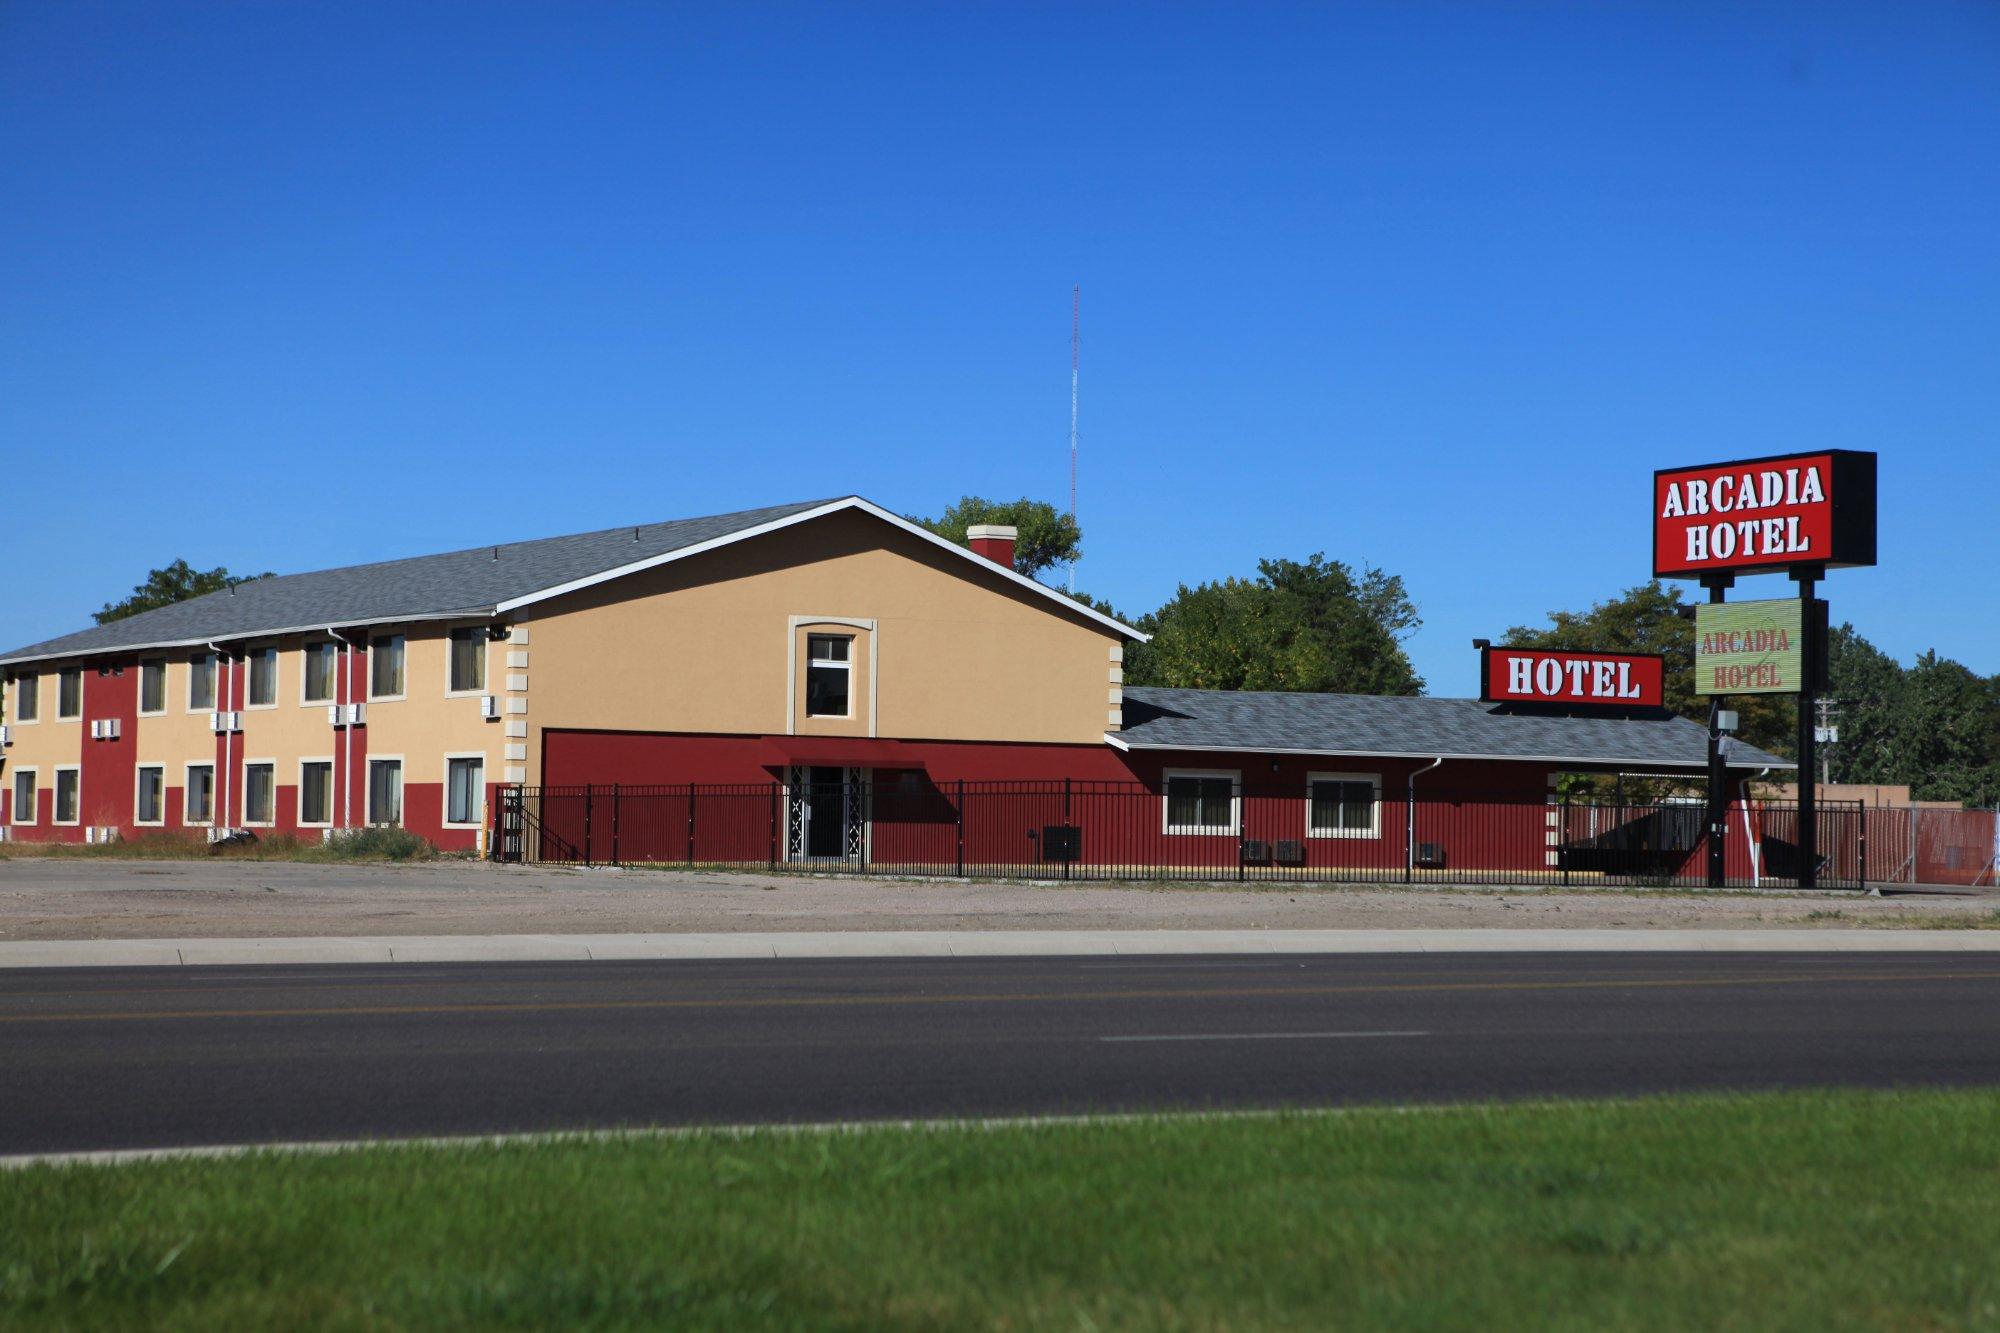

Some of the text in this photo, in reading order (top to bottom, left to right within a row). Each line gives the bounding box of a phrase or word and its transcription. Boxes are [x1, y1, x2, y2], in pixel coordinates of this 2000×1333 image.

[1662, 466, 1825, 518] ARCADIA
[1685, 516, 1809, 561] HOTEL
[1701, 628, 1790, 655] ARCADIA
[1507, 657, 1641, 698] HOTEL
[1713, 663, 1782, 689] HOTEL
